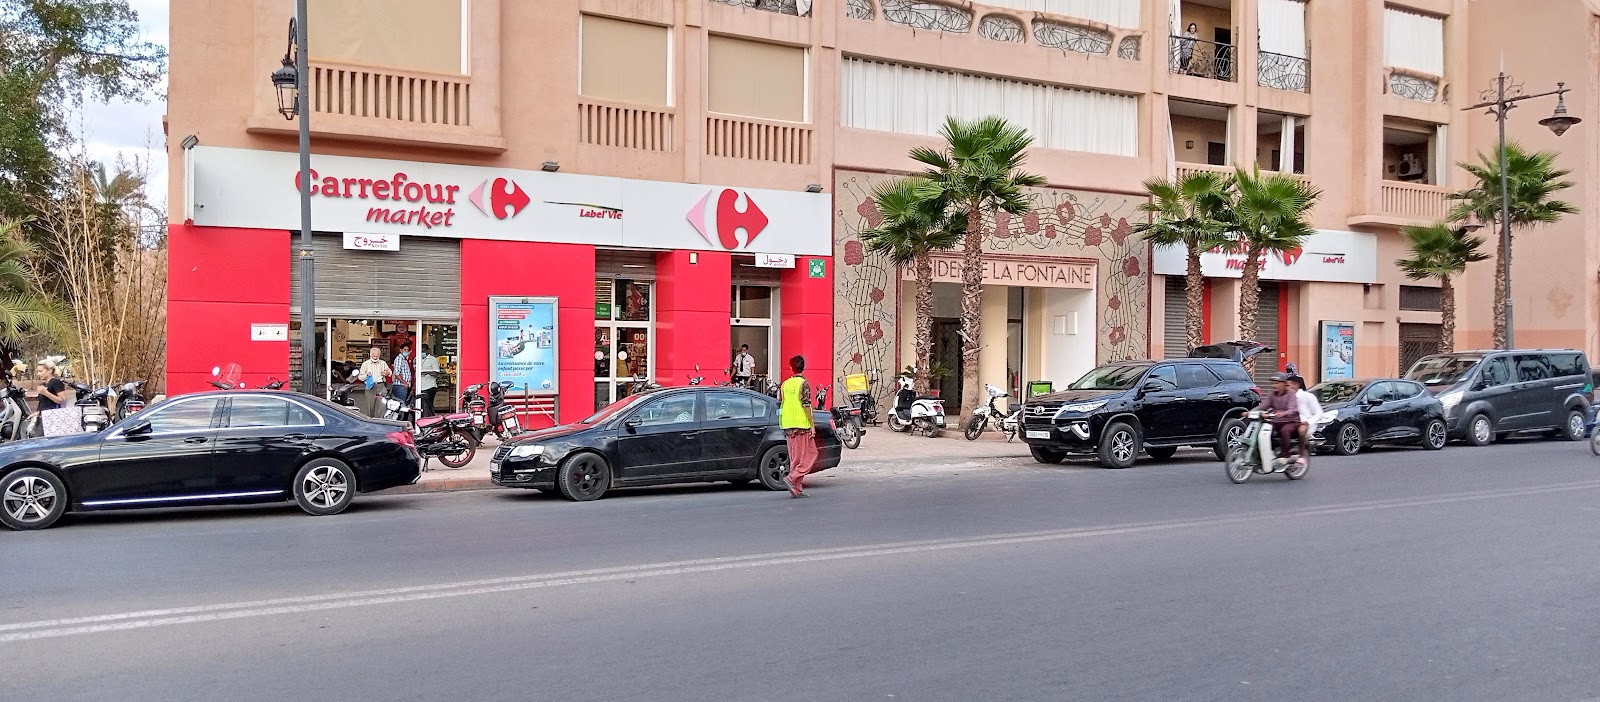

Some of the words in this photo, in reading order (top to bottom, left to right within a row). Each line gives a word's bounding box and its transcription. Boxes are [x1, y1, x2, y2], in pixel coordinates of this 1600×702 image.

[295, 168, 459, 204] Carrefour
[366, 206, 455, 229] market
[354, 235, 388, 248] خروج
[763, 254, 788, 266] دخول
[993, 262, 1013, 280] LA
[1017, 264, 1091, 284] FONTAINE
